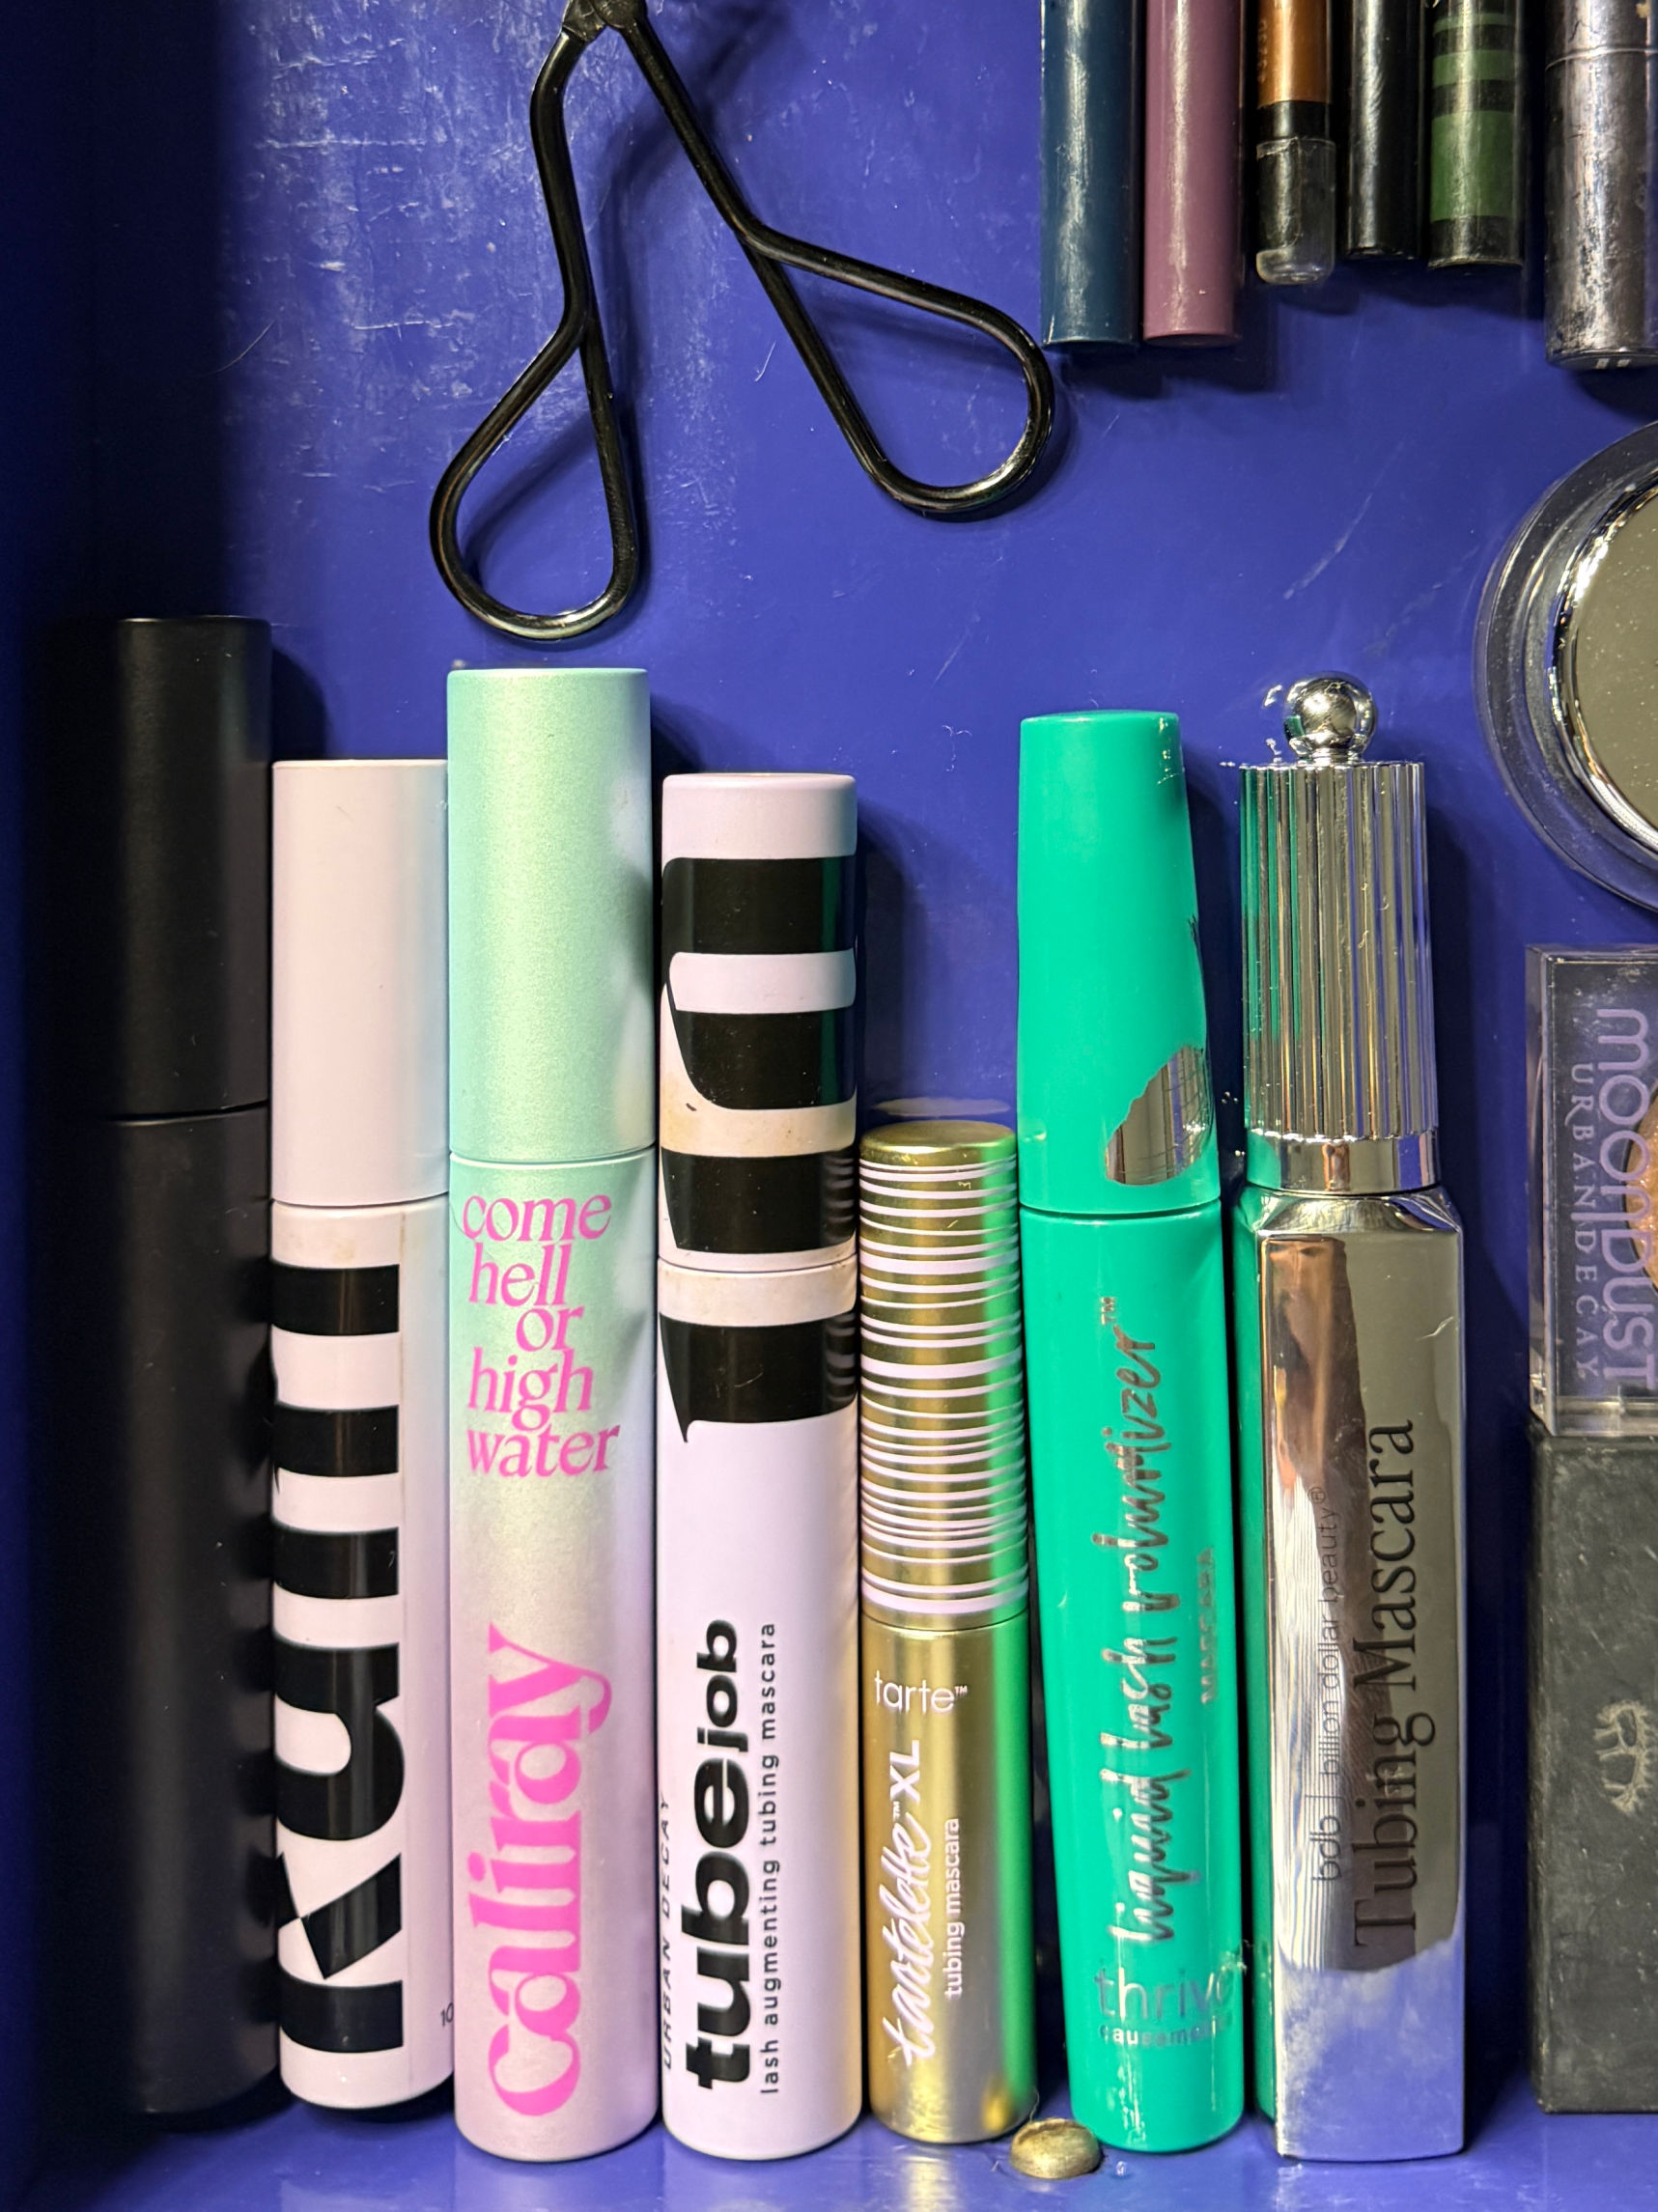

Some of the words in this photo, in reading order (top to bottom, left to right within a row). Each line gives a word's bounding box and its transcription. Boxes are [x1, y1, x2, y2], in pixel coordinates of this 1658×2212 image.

[1564, 1063, 1596, 1209] URBAN
[463, 1194, 612, 1242] come
[468, 1242, 573, 1307] hell
[1574, 1229, 1599, 1380] DECAY
[516, 1305, 585, 1352] or
[467, 1347, 594, 1432] high
[466, 1424, 621, 1477] water
[1352, 1419, 1418, 1691] Mascara
[761, 1622, 776, 1741] mascara
[1102, 1637, 1177, 1750] lash
[1316, 1614, 1340, 1691] dollar
[889, 1740, 920, 1803] XL
[1317, 1701, 1341, 1777] billion
[759, 1754, 779, 1846] tubing
[1353, 1711, 1435, 1947] Tubing
[467, 1622, 612, 2115] caliray
[660, 1793, 671, 1917] DECAY
[943, 1818, 961, 1917] mascara
[1100, 1769, 1201, 1945] liquid
[1309, 1813, 1342, 1883] bdb
[760, 1860, 780, 2026] augmenting
[942, 1922, 966, 2002] tubing
[662, 1946, 673, 2070] URBAN
[760, 2039, 778, 2095] lash
